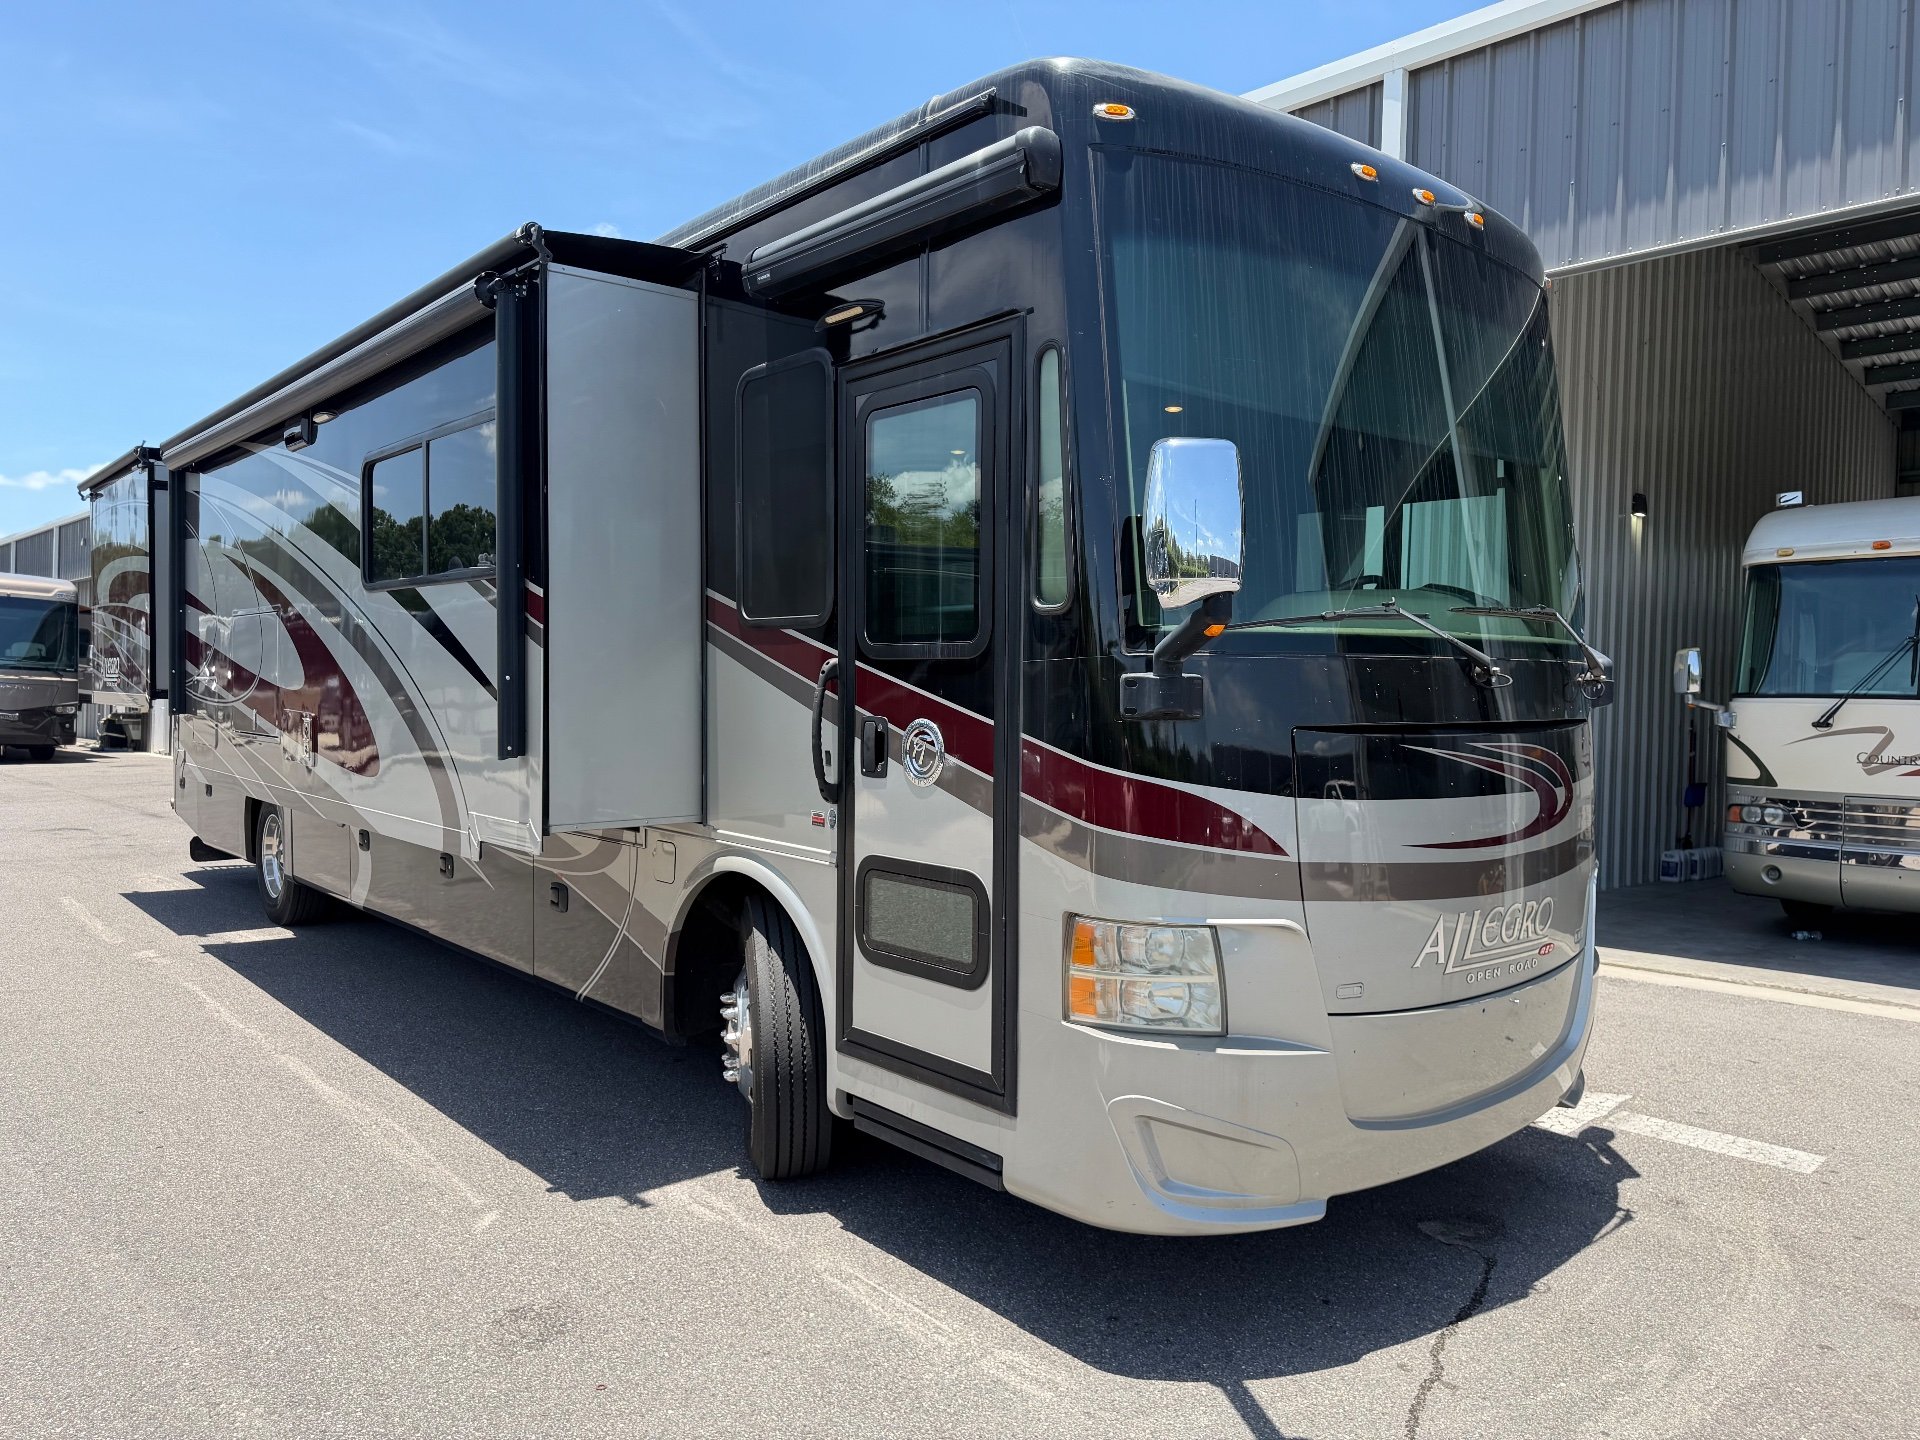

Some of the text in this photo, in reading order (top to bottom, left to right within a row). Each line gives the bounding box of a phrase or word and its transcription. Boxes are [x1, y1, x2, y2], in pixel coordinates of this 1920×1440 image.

[1856, 752, 1920, 766] COUNTR
[1411, 896, 1554, 975] ALLEGRO
[1466, 957, 1538, 984] OPEN ROAD
